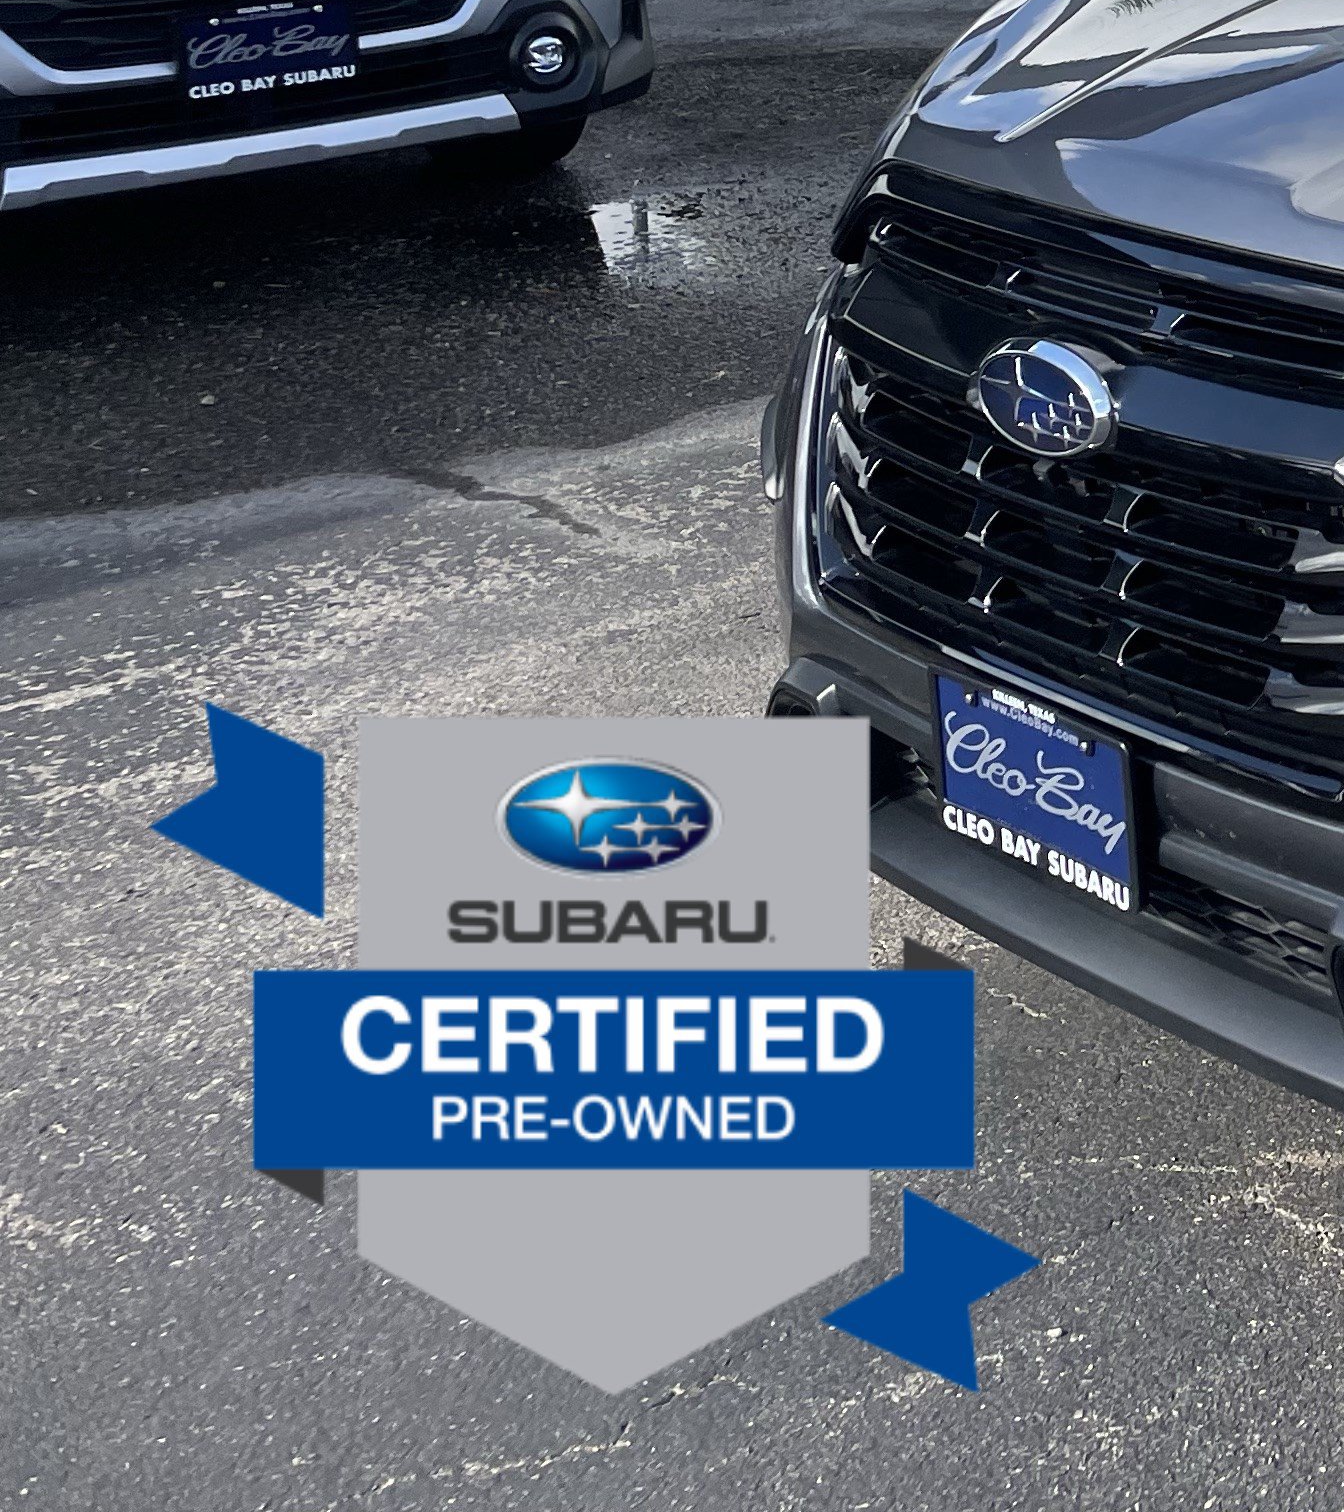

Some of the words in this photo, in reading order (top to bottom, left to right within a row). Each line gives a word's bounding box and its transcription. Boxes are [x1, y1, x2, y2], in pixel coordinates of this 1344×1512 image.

[188, 81, 235, 100] CLEO
[241, 74, 276, 92] BAY
[283, 64, 357, 85] SUBARU
[944, 710, 1036, 796] Cleo
[1034, 750, 1126, 855] Bay
[942, 805, 995, 846] CLEO
[1000, 827, 1042, 866] BAY
[1047, 849, 1130, 912] SUBARU
